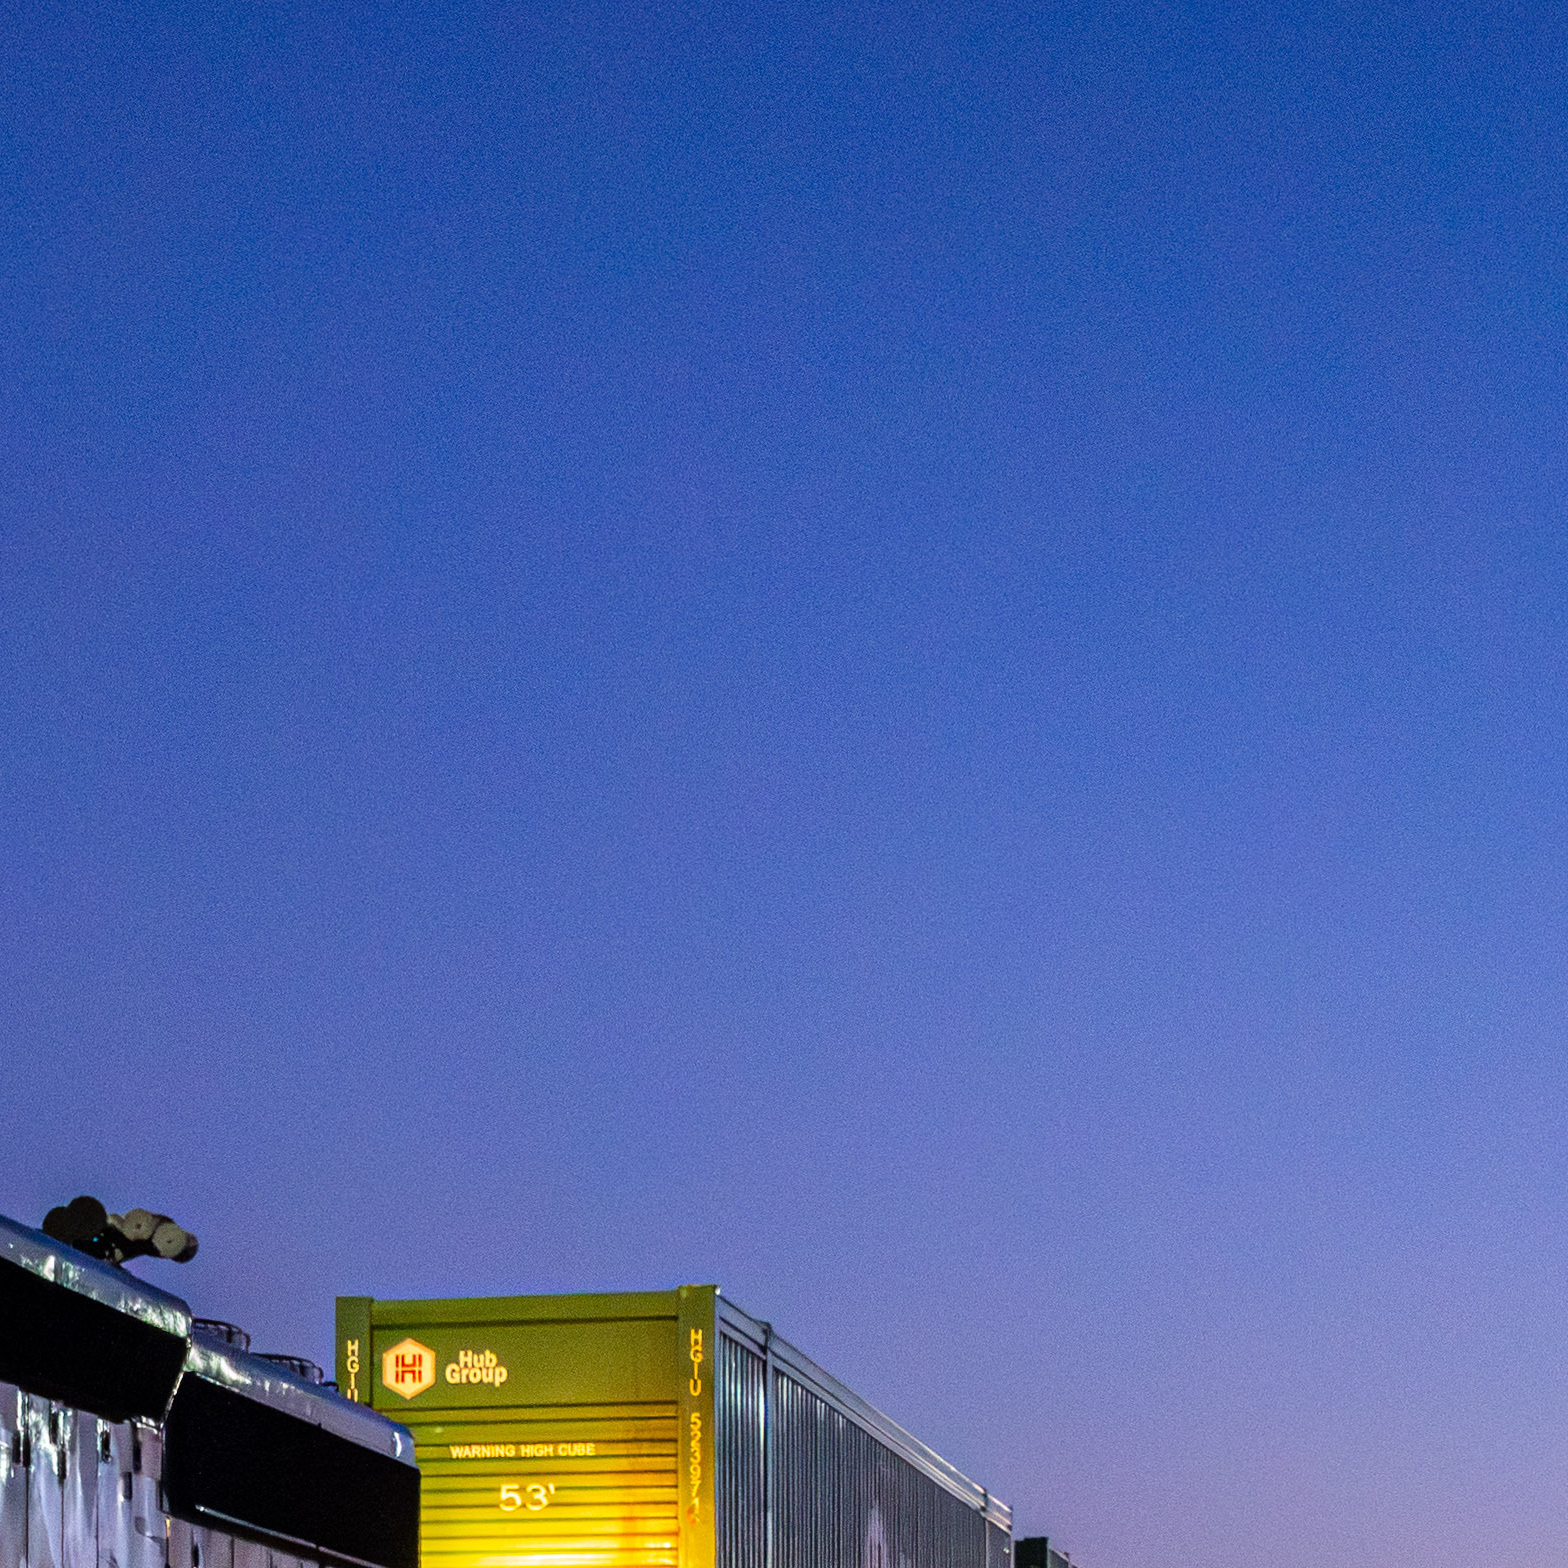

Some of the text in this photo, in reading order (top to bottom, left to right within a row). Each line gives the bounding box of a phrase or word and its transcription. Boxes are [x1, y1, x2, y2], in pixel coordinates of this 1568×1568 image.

[458, 1349, 498, 1369] Hub
[690, 1328, 703, 1397] HGIU
[445, 1362, 508, 1388] Group
[449, 1443, 596, 1459] WARNING HIGH CUBE
[499, 1483, 556, 1512] 53'
